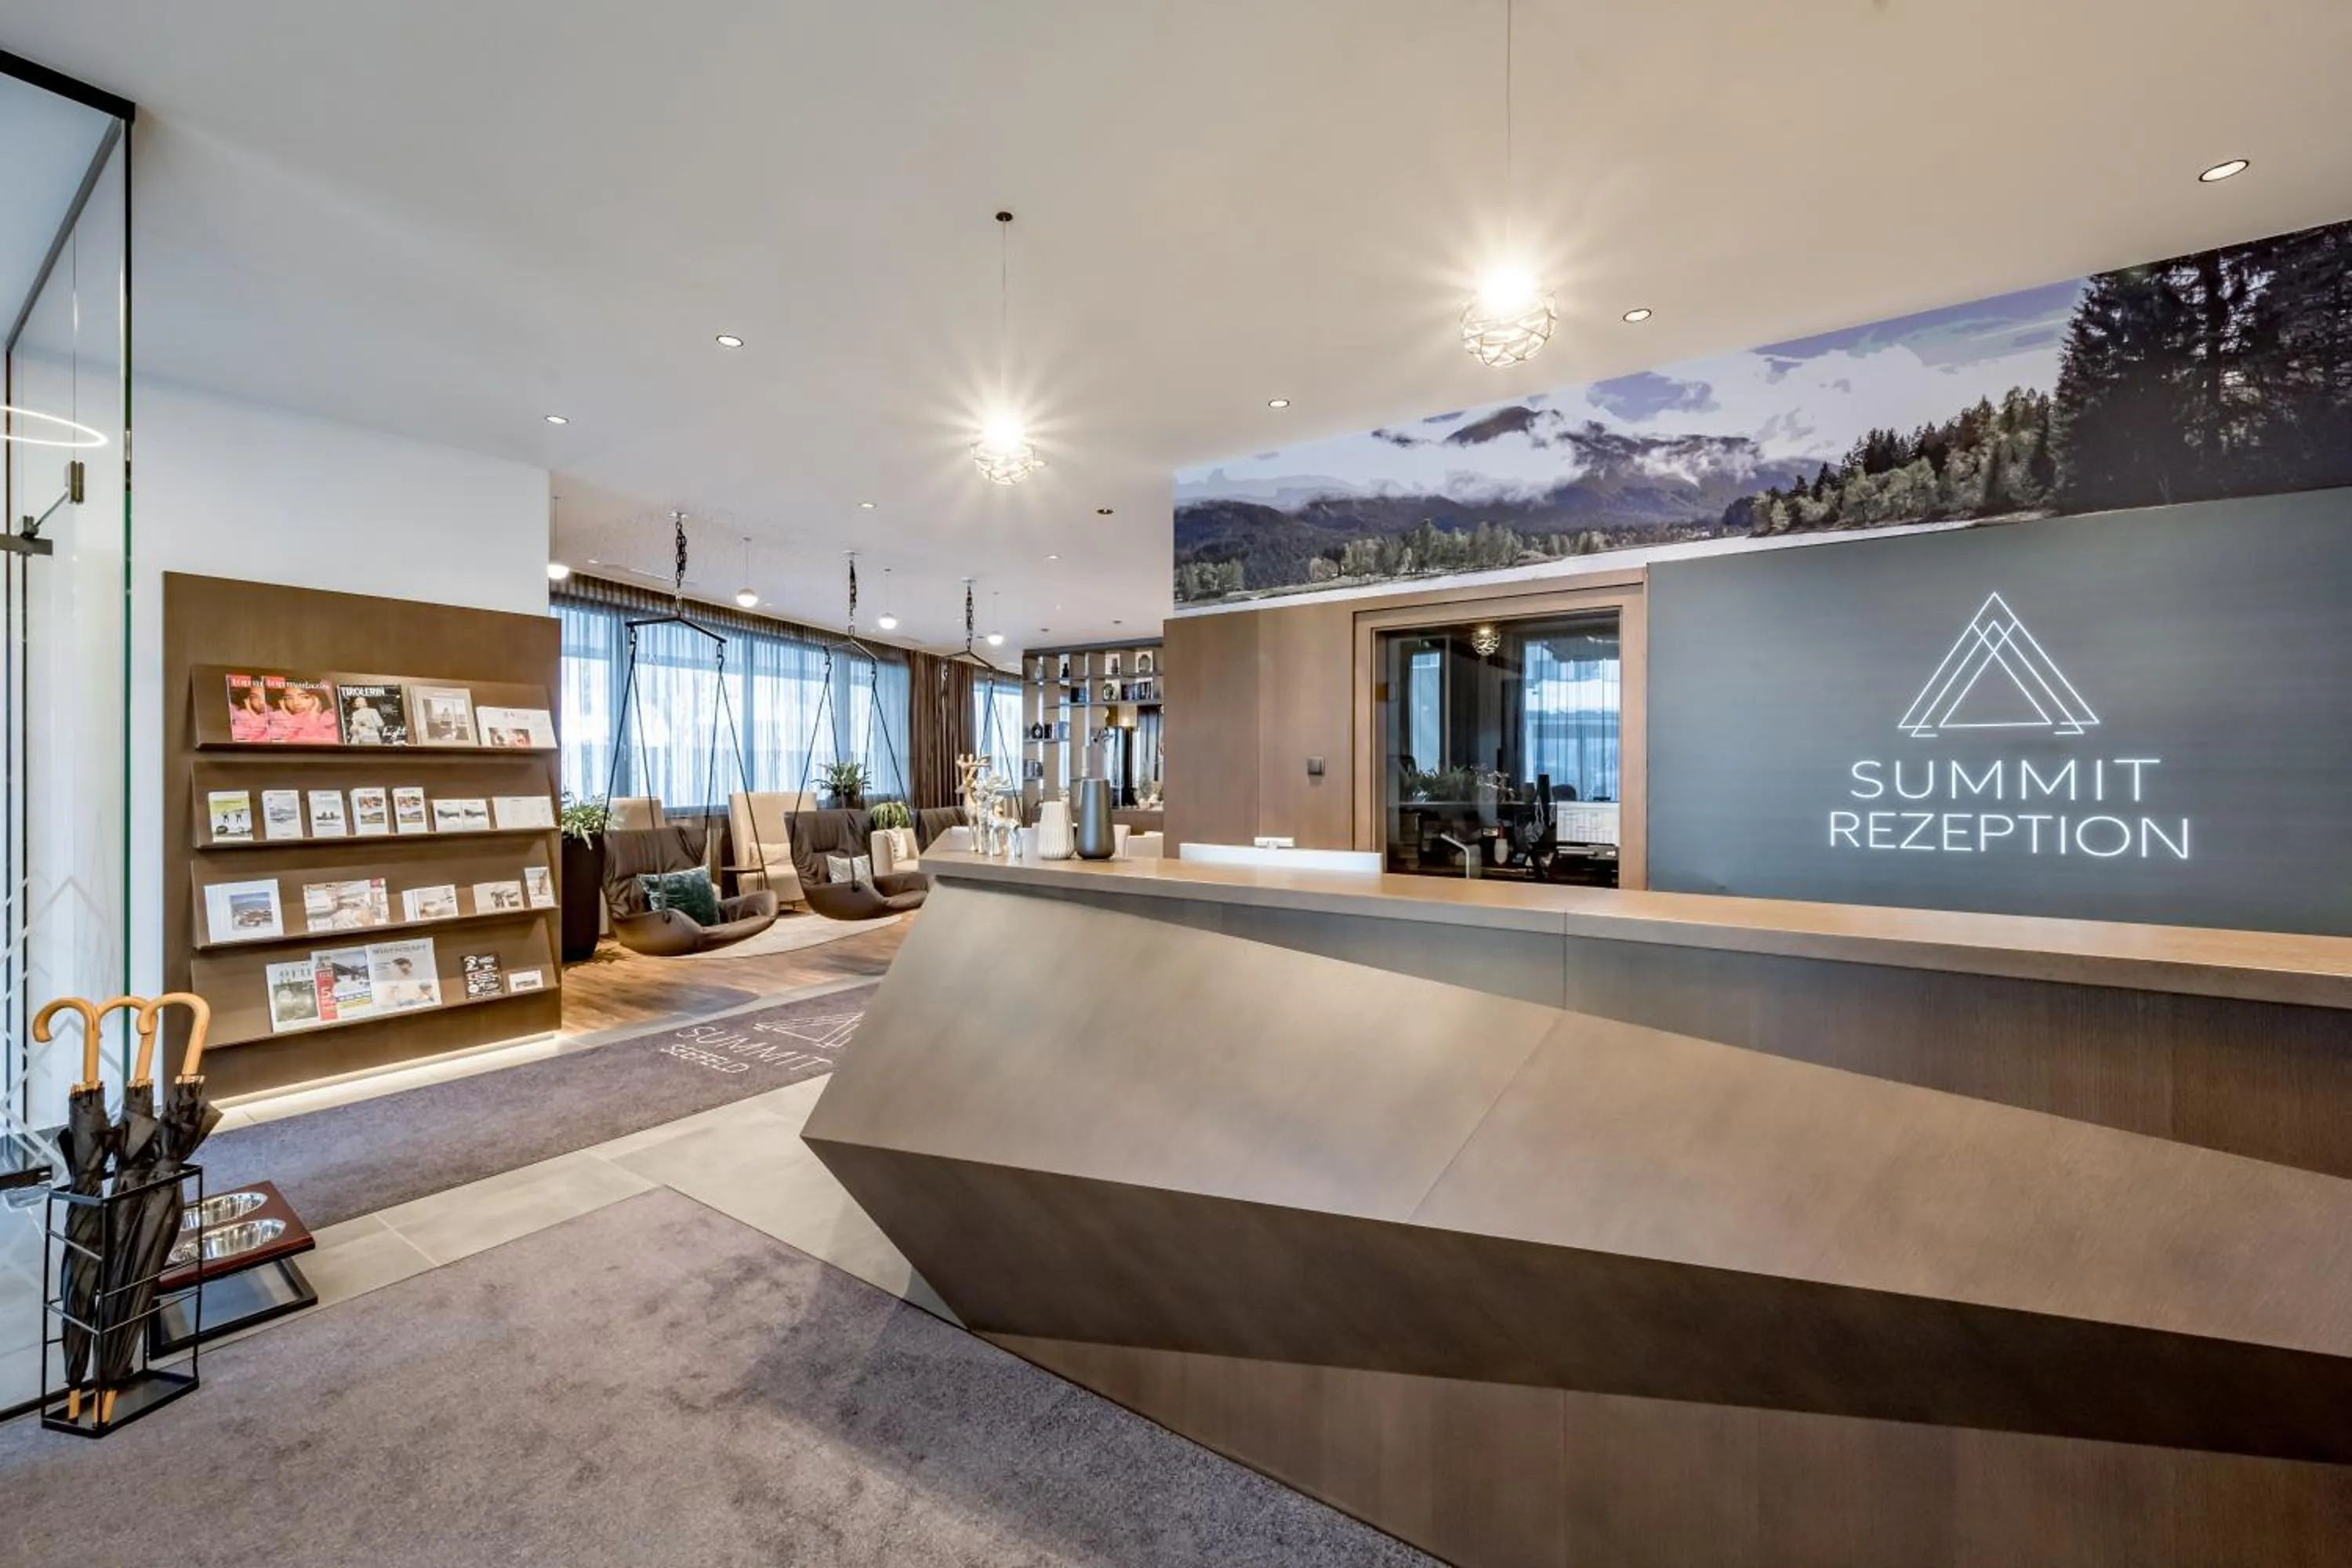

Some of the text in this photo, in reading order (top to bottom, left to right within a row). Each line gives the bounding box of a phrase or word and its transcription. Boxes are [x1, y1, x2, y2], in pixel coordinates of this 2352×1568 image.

[1850, 758, 2161, 802] SUMMIT
[1829, 811, 2188, 859] REZEPTION
[676, 1025, 833, 1071] SUMMIT
